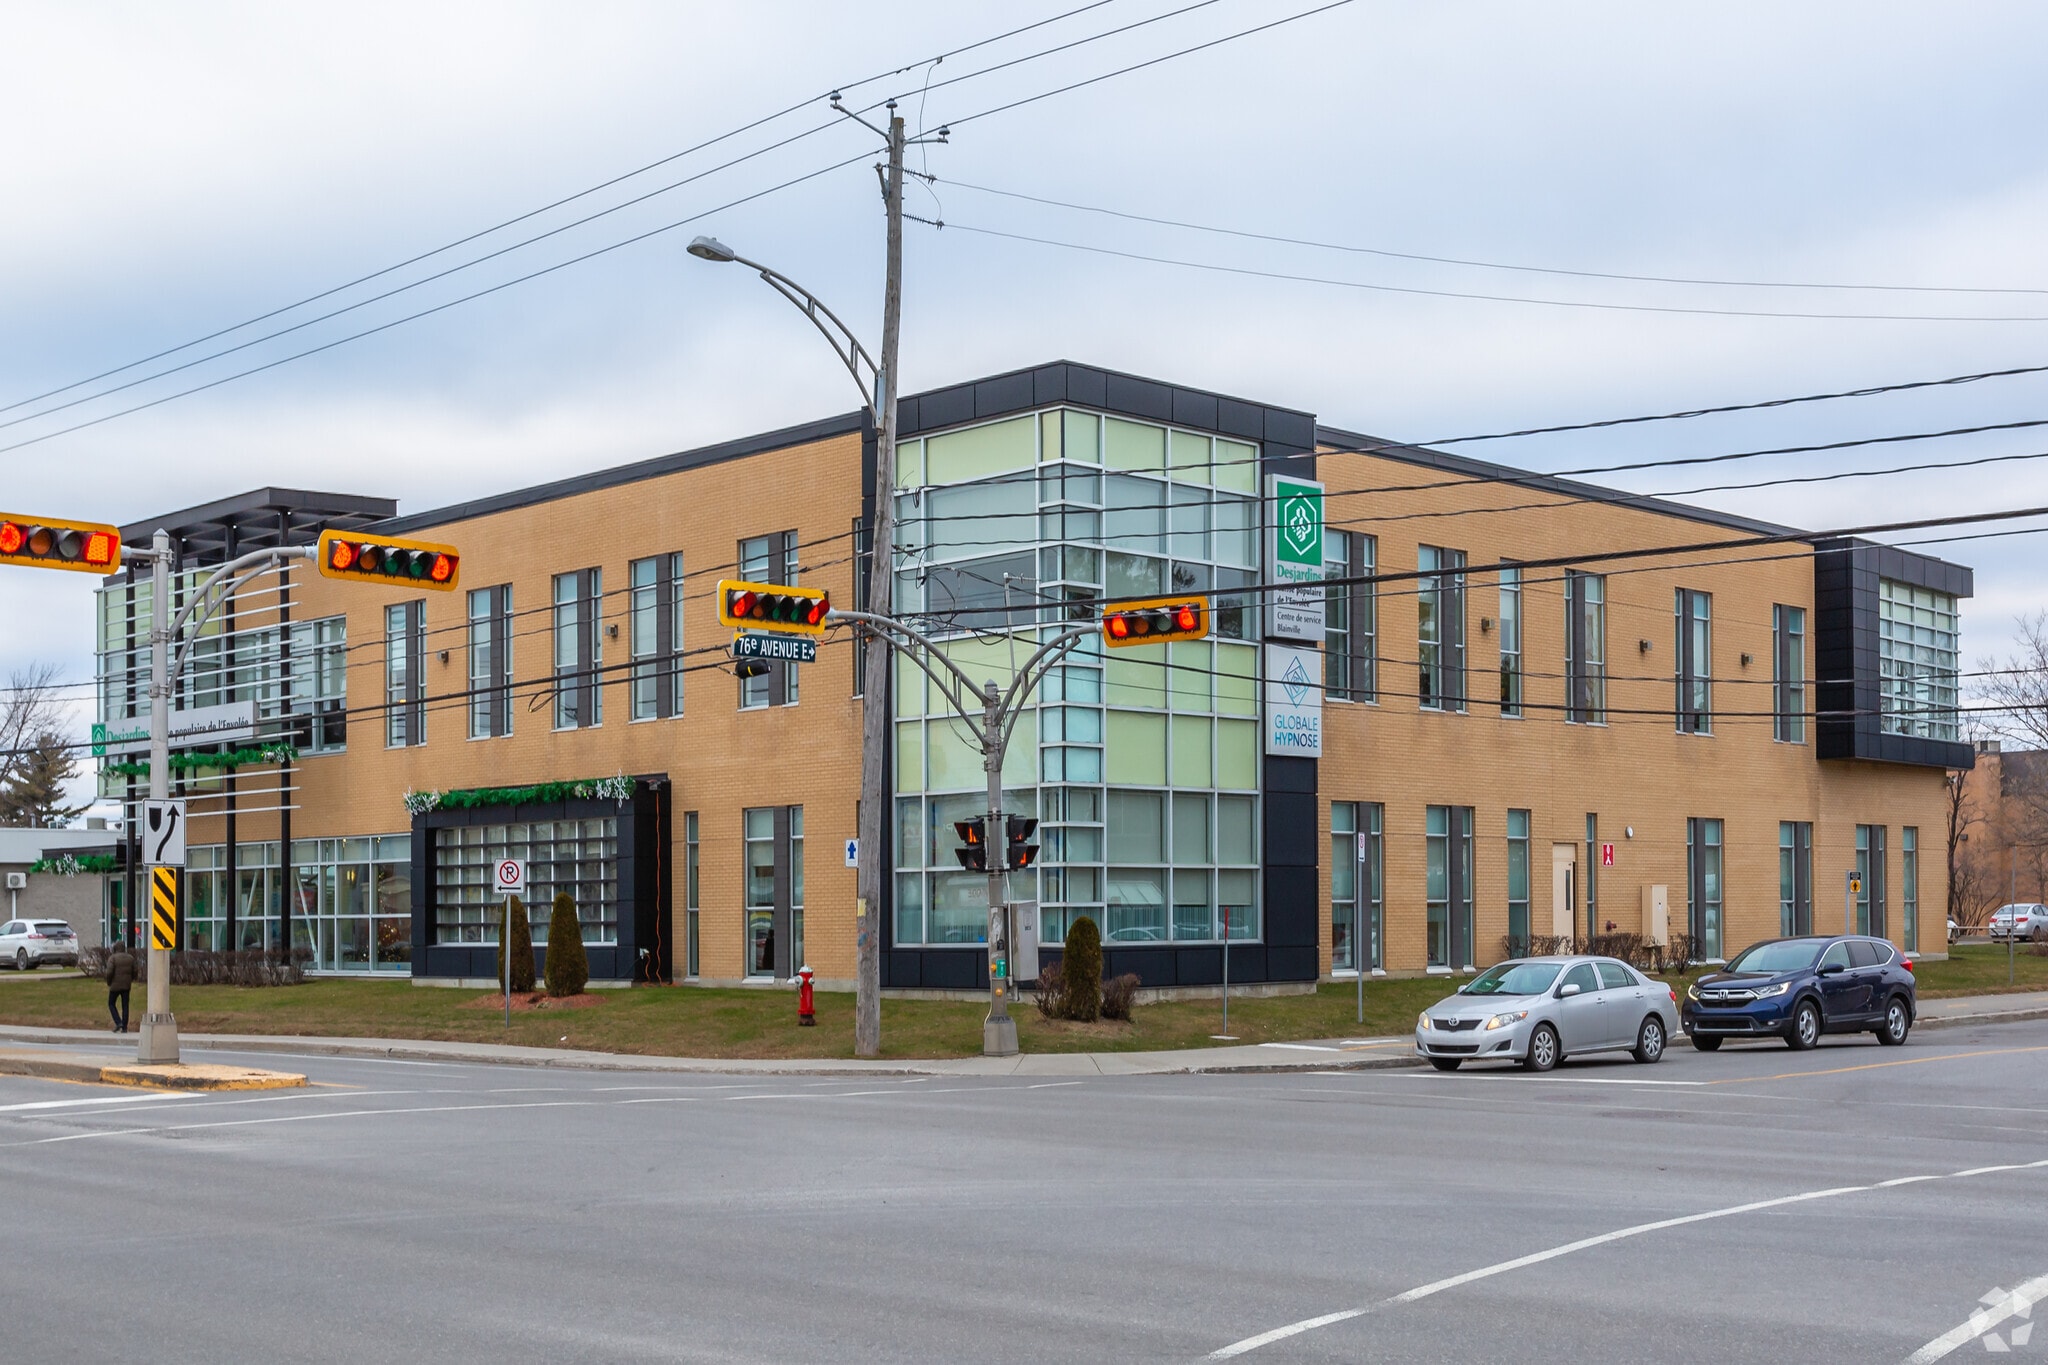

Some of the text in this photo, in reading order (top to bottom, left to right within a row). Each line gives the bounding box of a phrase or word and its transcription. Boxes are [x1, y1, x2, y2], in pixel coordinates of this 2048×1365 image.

[1277, 564, 1322, 583] Desjardins
[1277, 612, 1321, 624] Centre de service
[1277, 623, 1301, 634] Blainville
[760, 639, 799, 659] AVENUE
[801, 643, 810, 660] E.
[1274, 714, 1318, 731] GLOBALE
[107, 726, 150, 750] Desjardins
[1274, 731, 1318, 748] HYPNOSE
